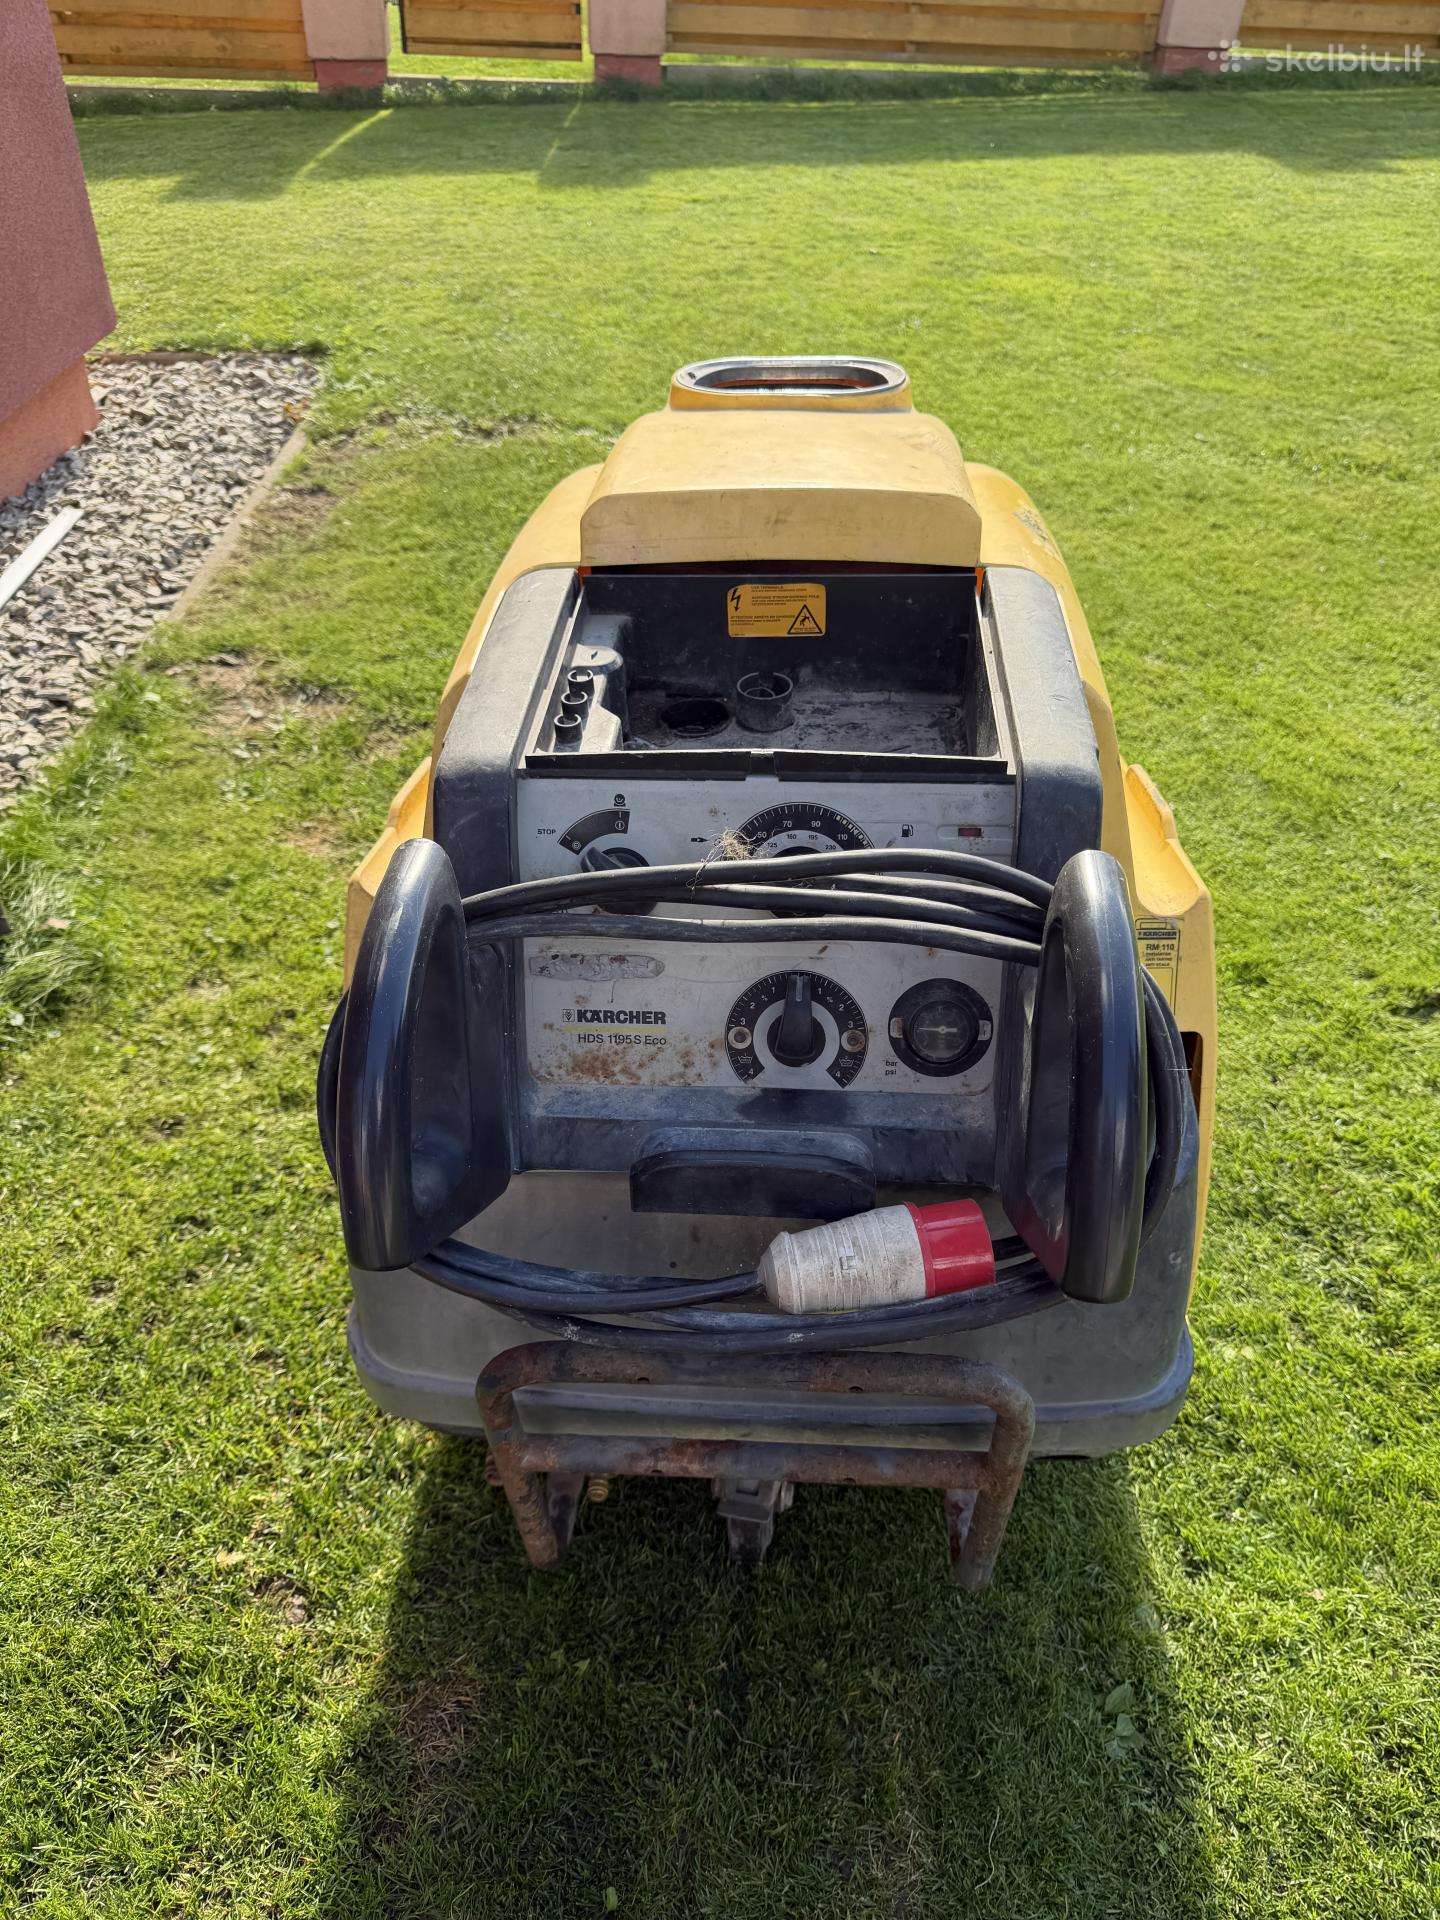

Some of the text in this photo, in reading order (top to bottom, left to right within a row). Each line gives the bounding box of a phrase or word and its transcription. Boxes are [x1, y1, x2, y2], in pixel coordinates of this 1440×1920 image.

[782, 820, 793, 828] 70
[811, 820, 821, 828] 90
[757, 831, 767, 839] 50
[838, 833, 848, 841] 110
[1162, 943, 1175, 951] 110
[750, 1001, 756, 1009] 2
[576, 1009, 667, 1025] KÄRCHER
[740, 1017, 746, 1025] 3
[577, 1033, 604, 1044] HDS
[644, 1035, 667, 1046] Eco
